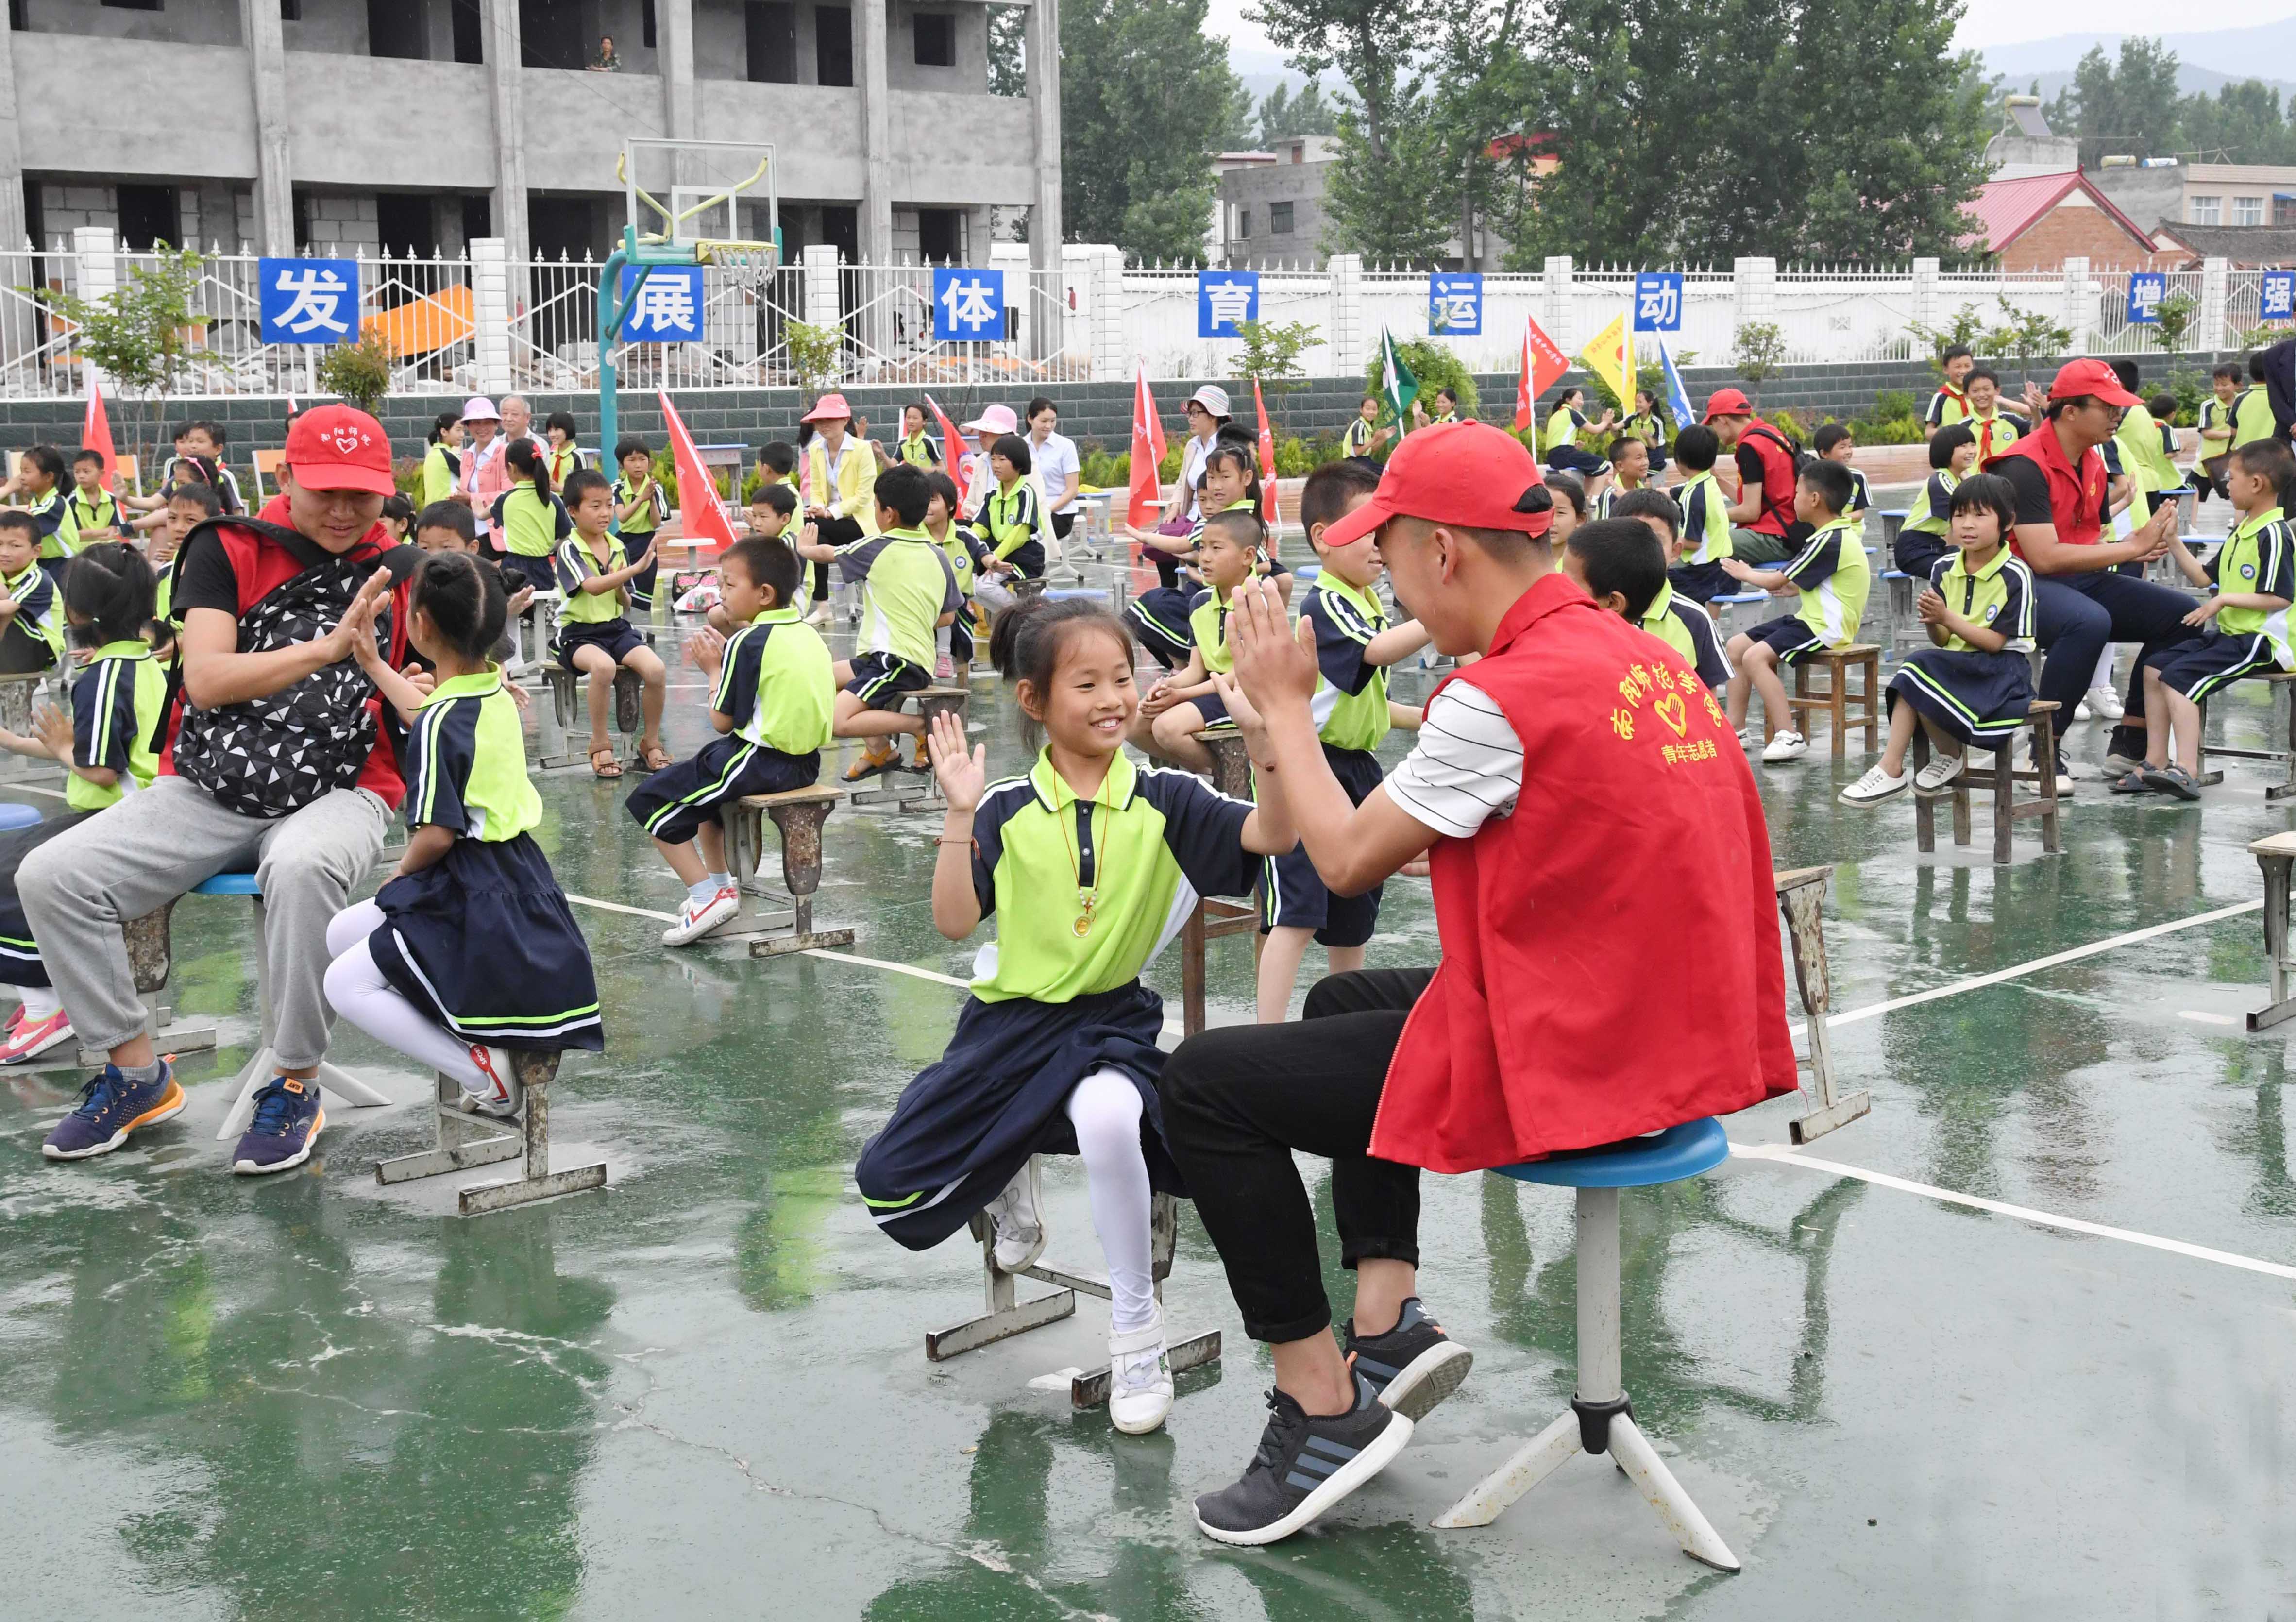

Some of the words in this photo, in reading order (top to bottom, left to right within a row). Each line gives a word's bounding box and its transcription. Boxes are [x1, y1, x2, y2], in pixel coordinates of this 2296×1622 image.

[272, 269, 349, 333] 发
[630, 273, 695, 332] 展
[941, 278, 997, 331] 体
[1205, 279, 1252, 330] 育
[1435, 281, 1477, 328] 运
[1639, 280, 1677, 325] 动
[2132, 279, 2161, 317] 增
[2265, 277, 2290, 313] 强
[1661, 738, 1718, 765] 青年志愿者
